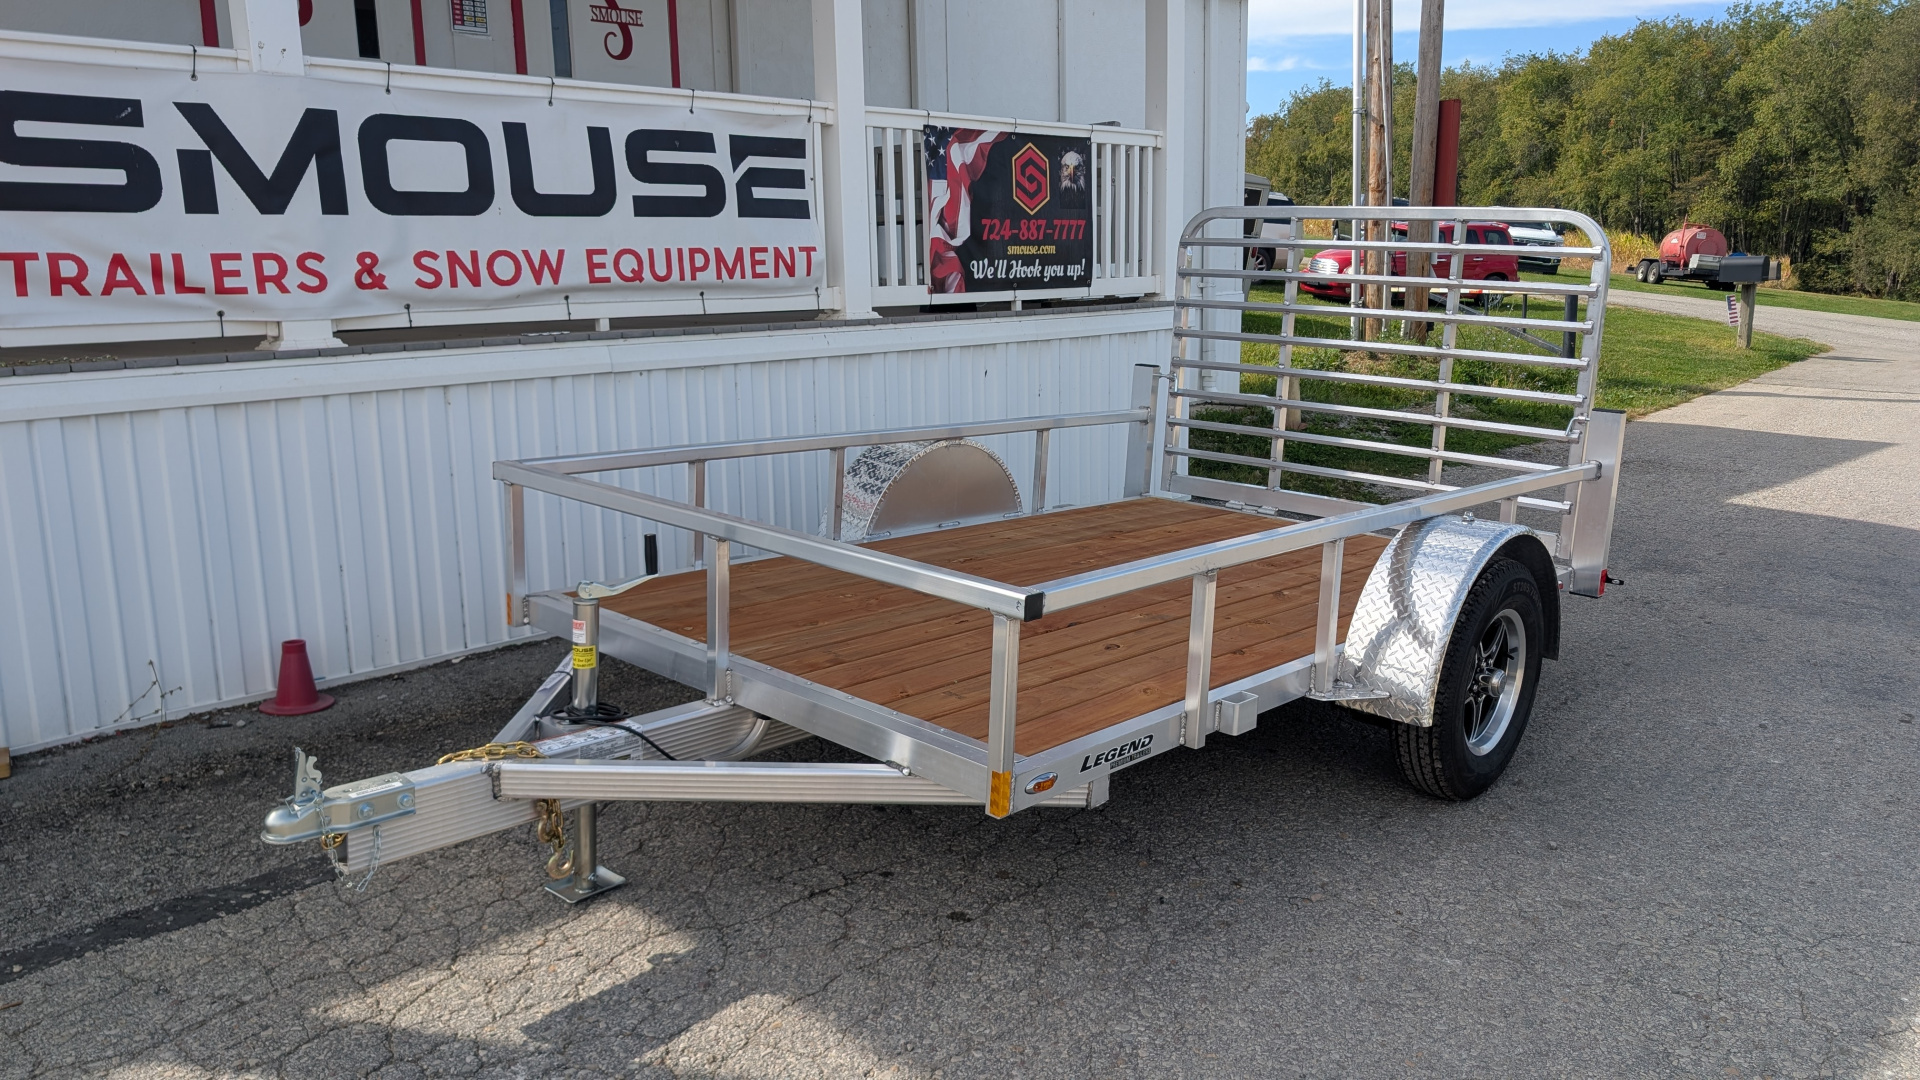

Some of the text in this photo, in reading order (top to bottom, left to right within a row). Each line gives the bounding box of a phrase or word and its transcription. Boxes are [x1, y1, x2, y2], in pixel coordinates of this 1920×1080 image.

[591, 6, 643, 25] SMOUSE
[0, 90, 811, 219] SMOUSE
[981, 218, 1086, 241] 724-887-7777
[1007, 245, 1056, 255] smouse.com
[0, 246, 817, 297] TRAILERS & SNOW EQUIPMENT
[970, 258, 1086, 282] We'll Hook you up!
[1079, 734, 1154, 773] LEGEND
